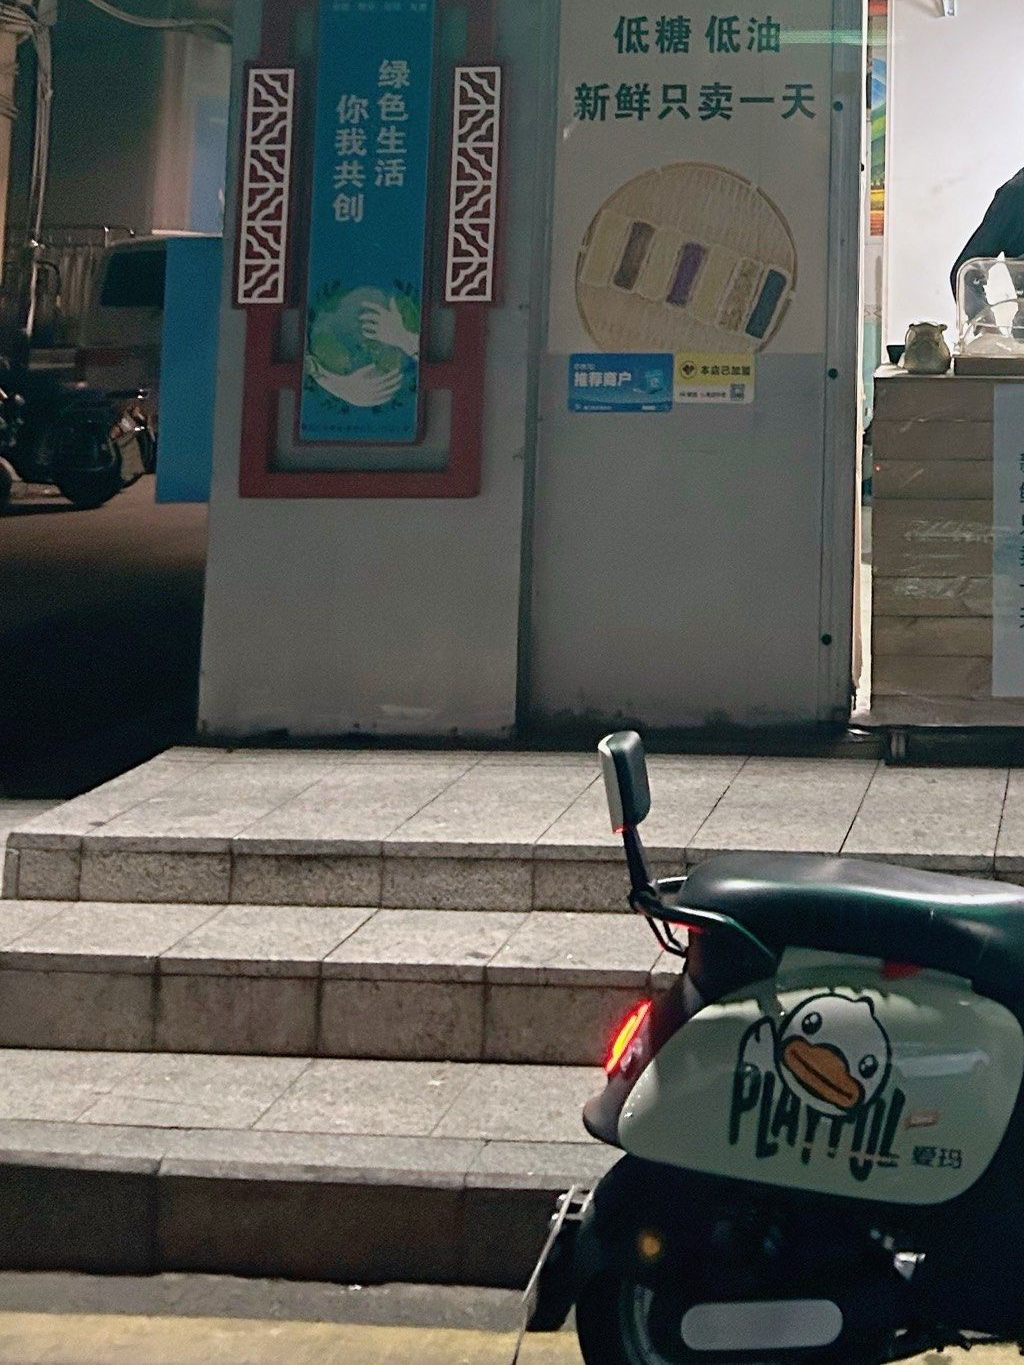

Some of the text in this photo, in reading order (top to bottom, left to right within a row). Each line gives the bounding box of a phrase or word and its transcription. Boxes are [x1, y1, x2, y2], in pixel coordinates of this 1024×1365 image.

[613, 15, 781, 54] 低糖 低油
[375, 59, 410, 187] 绿色生活
[573, 82, 816, 122] 新鲜只卖一天
[333, 94, 369, 223] 你我共创
